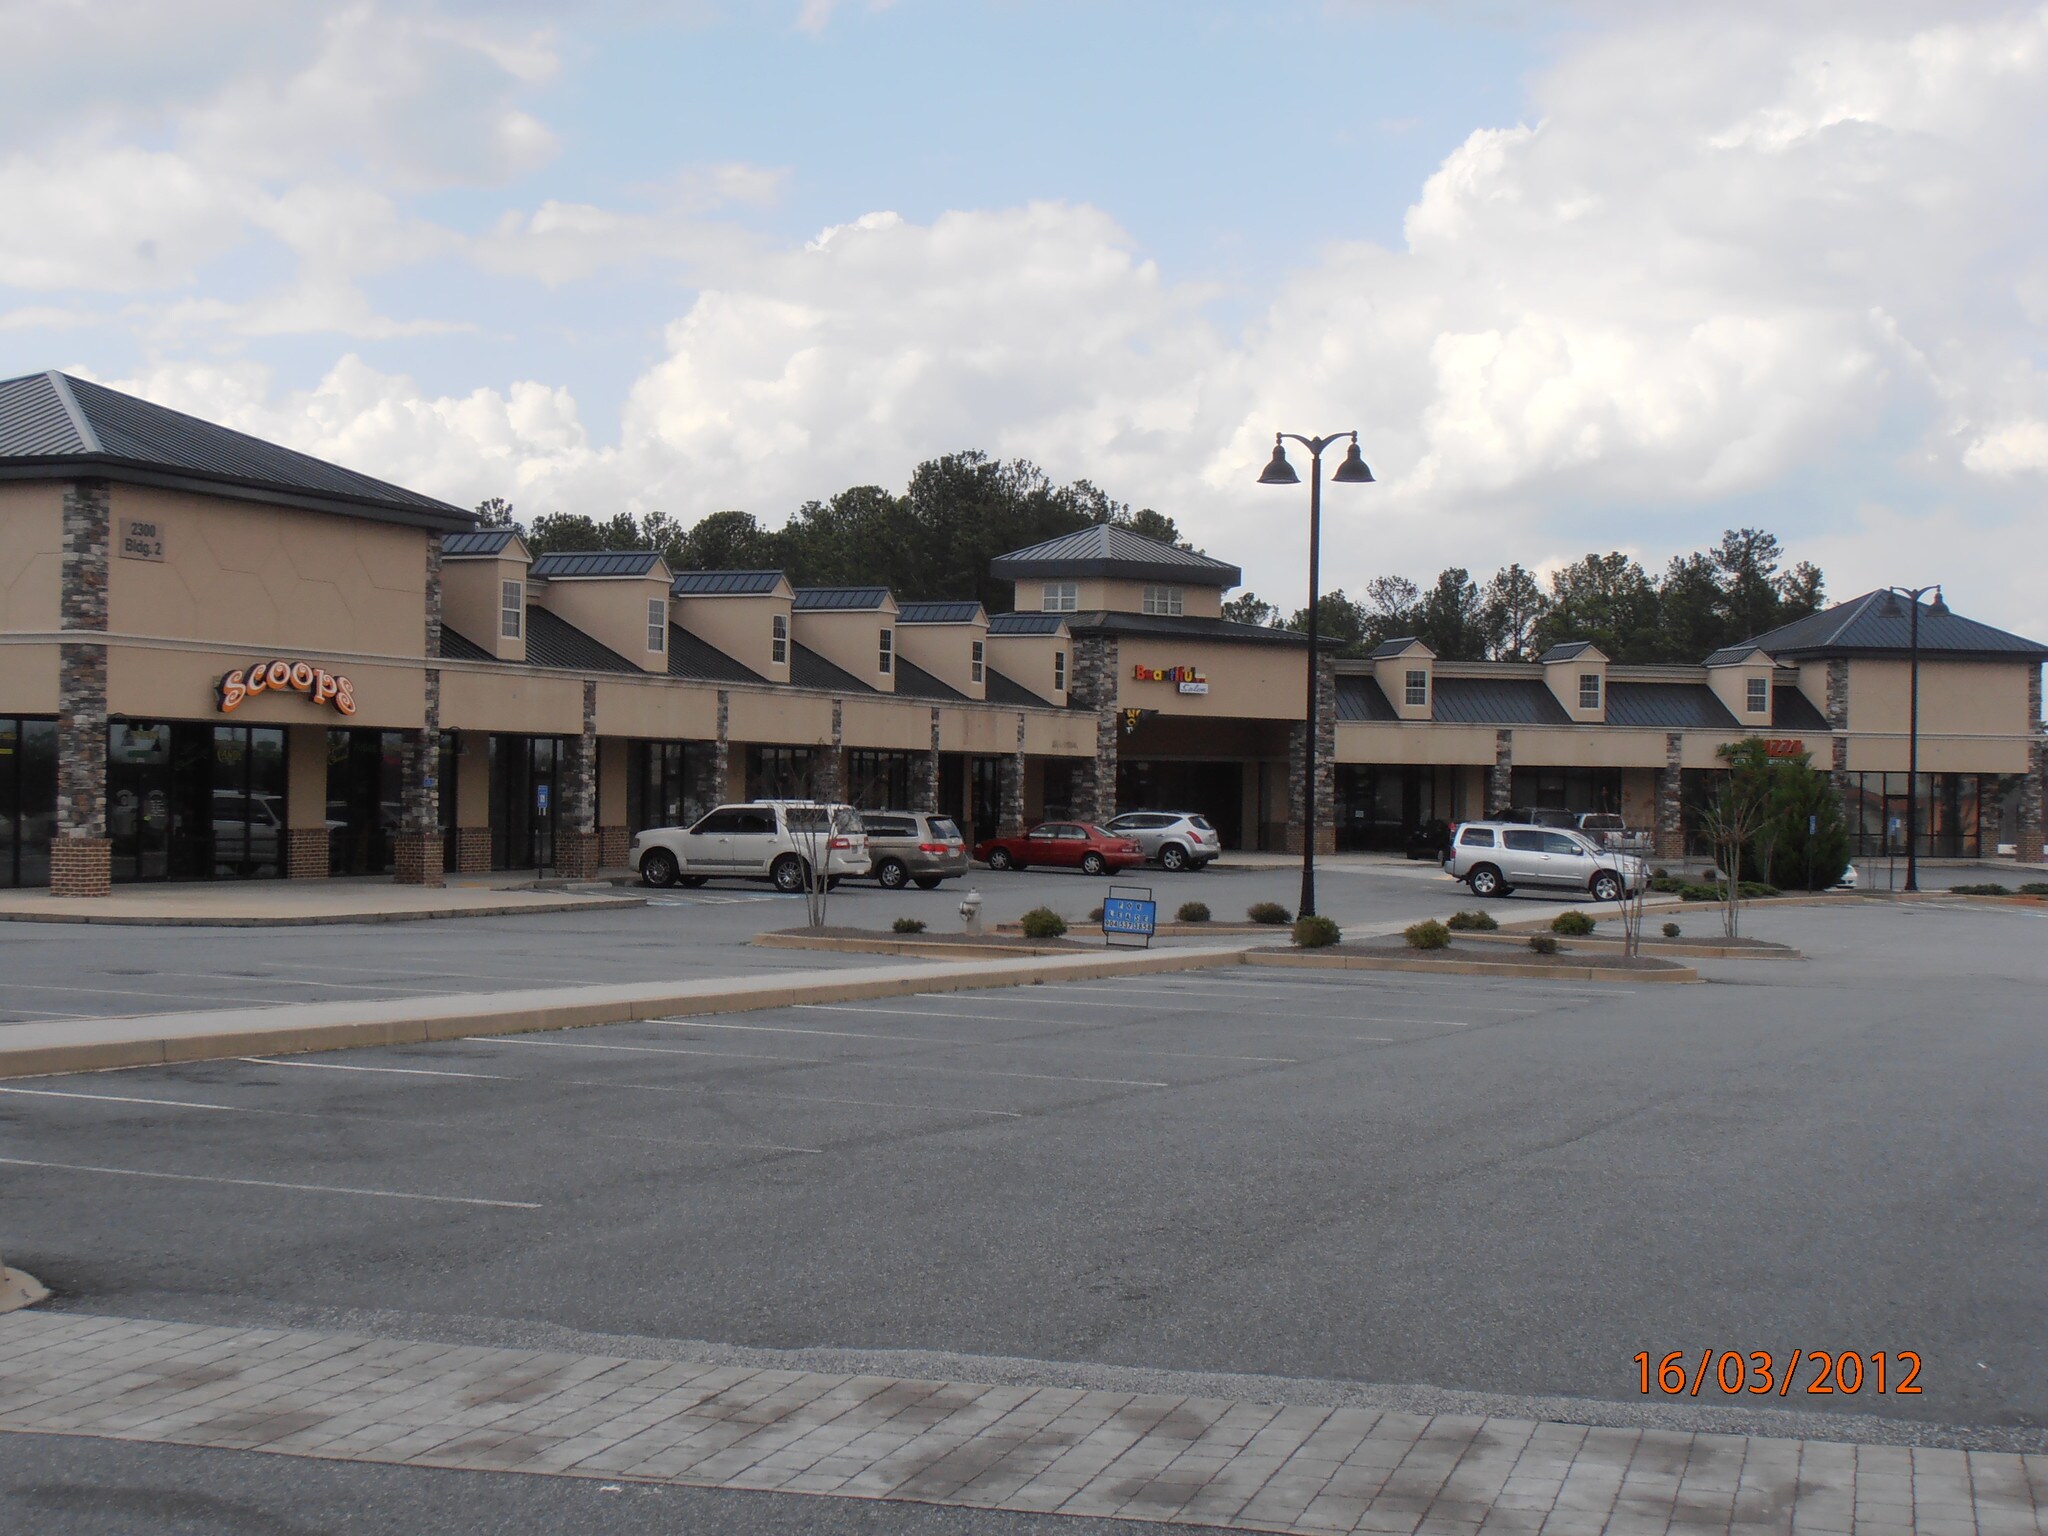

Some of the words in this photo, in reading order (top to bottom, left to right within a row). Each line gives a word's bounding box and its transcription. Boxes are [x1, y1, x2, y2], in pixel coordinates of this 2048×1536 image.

[131, 522, 156, 538] 2300
[125, 538, 153, 558] Bldg.
[154, 541, 162, 556] 2
